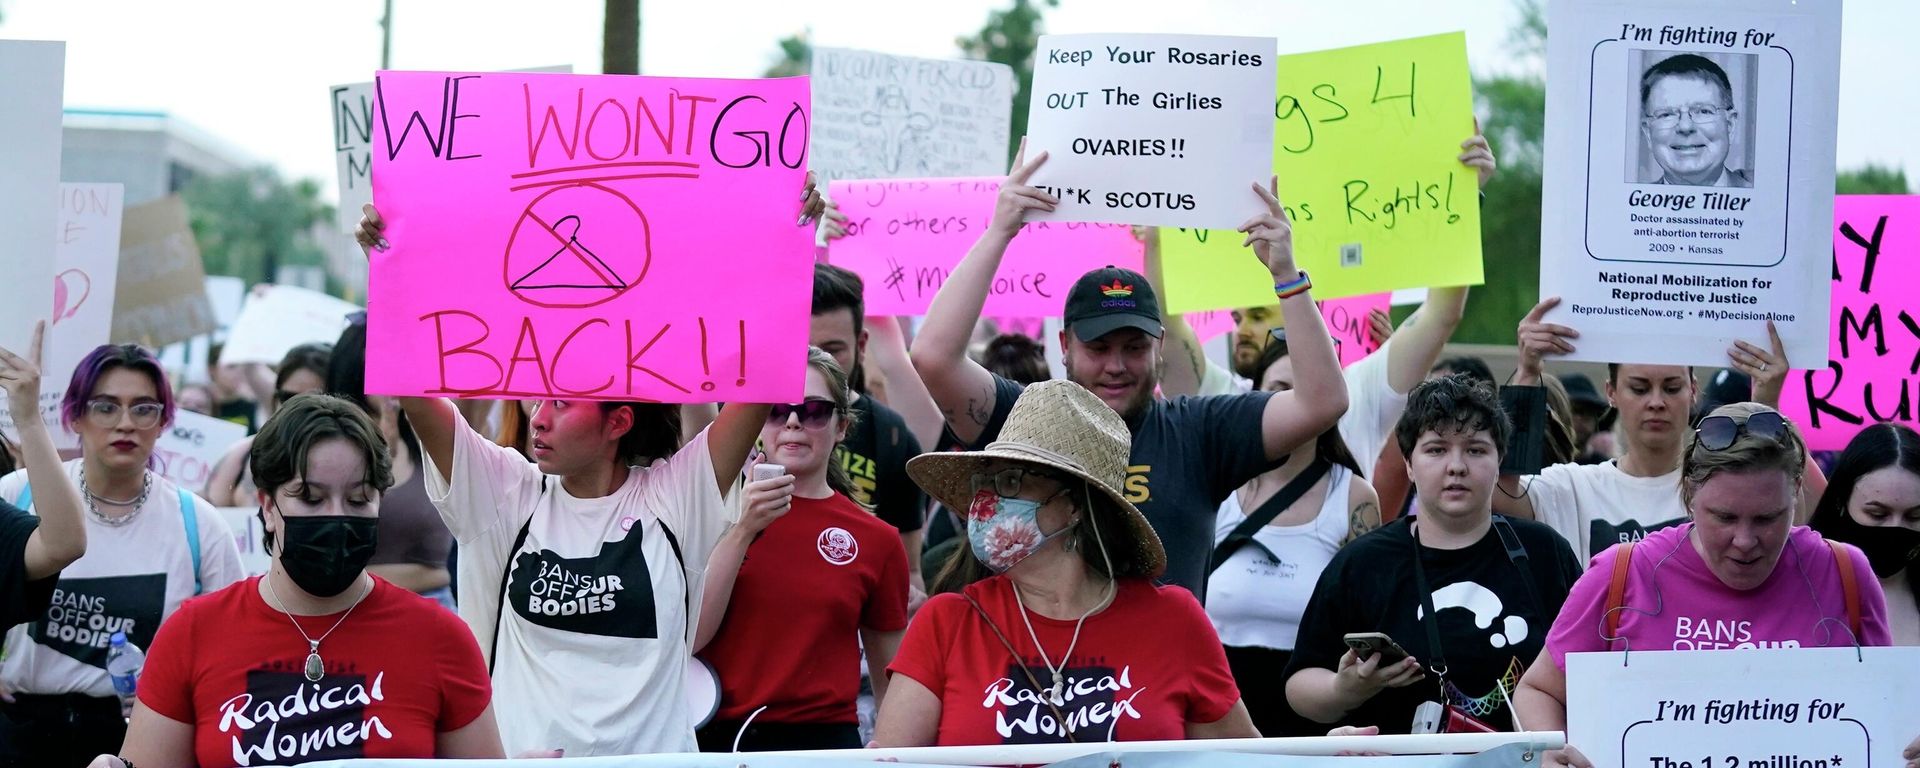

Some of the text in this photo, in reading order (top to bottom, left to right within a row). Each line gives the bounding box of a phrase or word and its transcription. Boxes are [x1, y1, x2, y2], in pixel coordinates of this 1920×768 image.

[1619, 24, 1775, 48] I'm fighting for
[1049, 46, 1262, 67] Keep Your Rosaries
[1046, 86, 1223, 110] OUT The Girlies
[1371, 62, 1415, 117] 4
[376, 76, 482, 161] WE
[710, 95, 807, 169] GO
[1072, 137, 1185, 158] OVARIES!!
[1105, 191, 1196, 210] SCOTUS
[1344, 172, 1460, 229] Rights!
[1628, 190, 1751, 211] George Tiller
[887, 211, 968, 235] others
[1630, 213, 1744, 228] Doctor assassinated by
[1633, 228, 1740, 240] anti-abortion terrorist
[1648, 243, 1723, 254] 2009 Kansas
[1598, 272, 1772, 289] National Mobilization for
[1101, 300, 1136, 308] adidas
[1611, 288, 1758, 304] Reproductive Justice
[1572, 304, 1796, 322] ReproJusticeNow.org #MyDecisionAlone
[419, 310, 746, 394] BACK!!
[538, 560, 592, 588] BANS
[50, 588, 106, 613] BANS
[530, 577, 574, 600] OFF
[528, 593, 616, 616] BODIES
[48, 605, 135, 634] OFF OUR
[1675, 616, 1752, 642] BANS
[46, 621, 111, 648] BODIE
[982, 665, 1132, 708] Radical
[218, 671, 384, 732] Radical
[1655, 698, 1845, 724] I'm fighting for
[995, 701, 1141, 738] Women
[232, 716, 392, 767] Women
